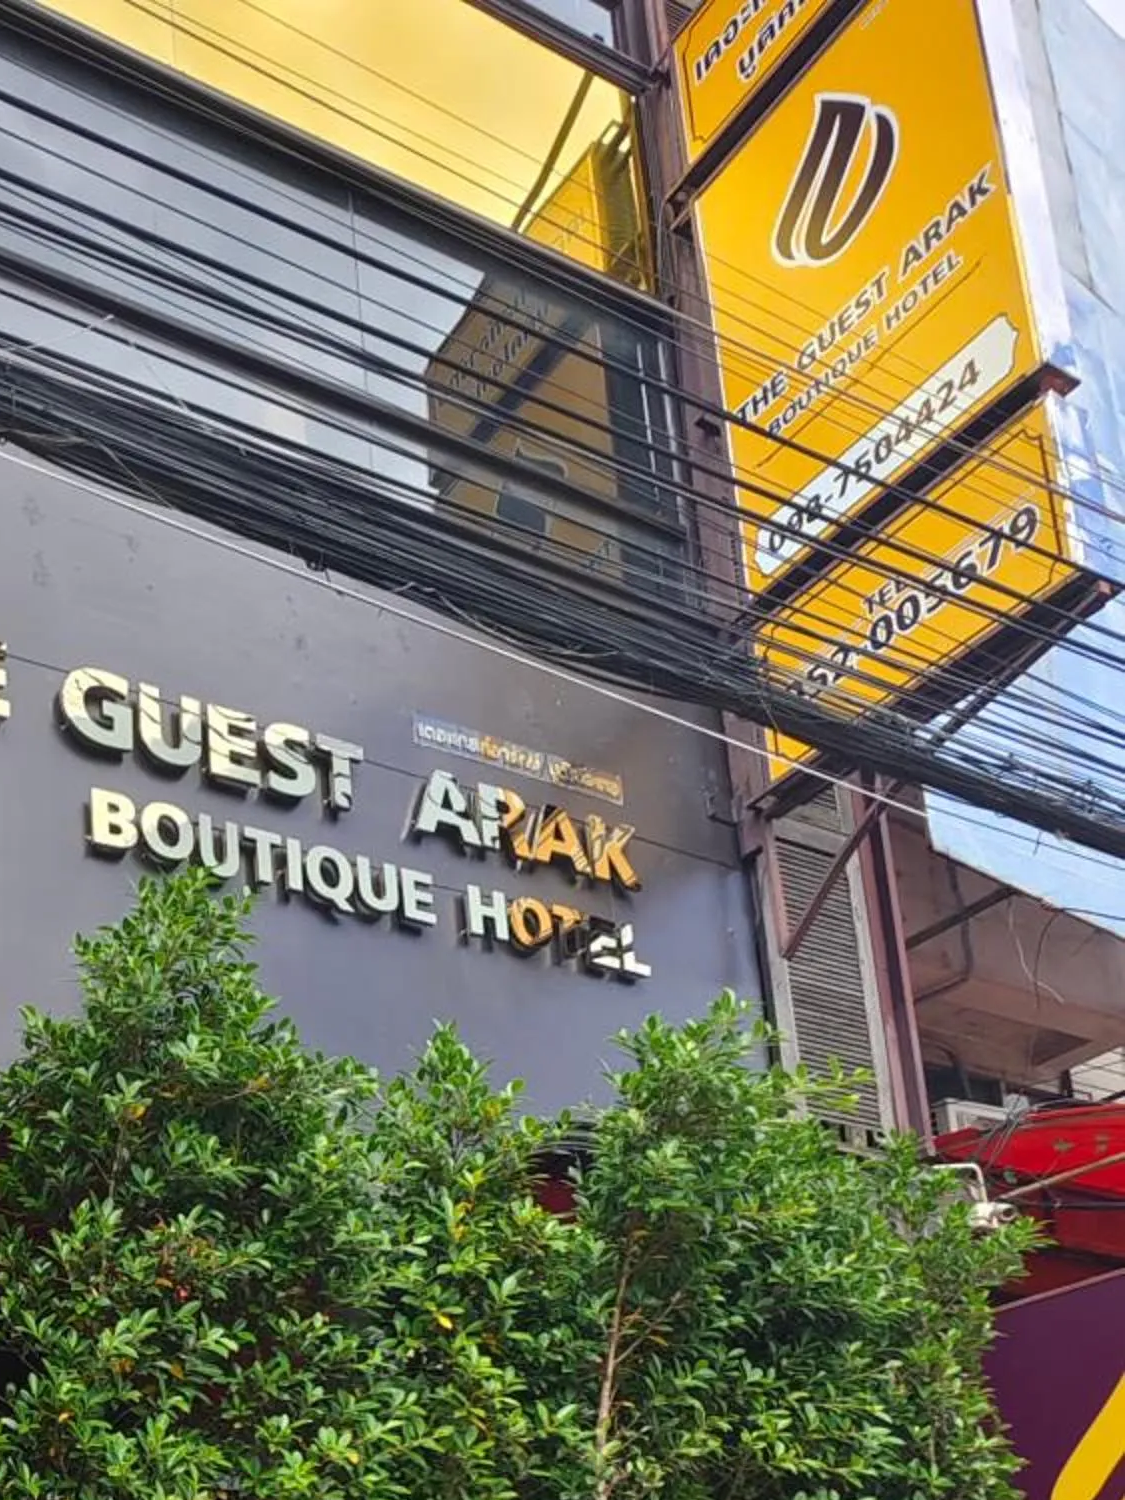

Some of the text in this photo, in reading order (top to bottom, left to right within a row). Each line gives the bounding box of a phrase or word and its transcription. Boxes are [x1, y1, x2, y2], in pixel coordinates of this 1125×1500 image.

[736, 171, 992, 423] THE GUEST ARAK
[768, 255, 962, 435] BOUTIQUE HOTEL
[61, 667, 364, 812] GUEST
[416, 769, 642, 891] ARAK
[91, 787, 652, 978] BOUTIQUE HOTEL
